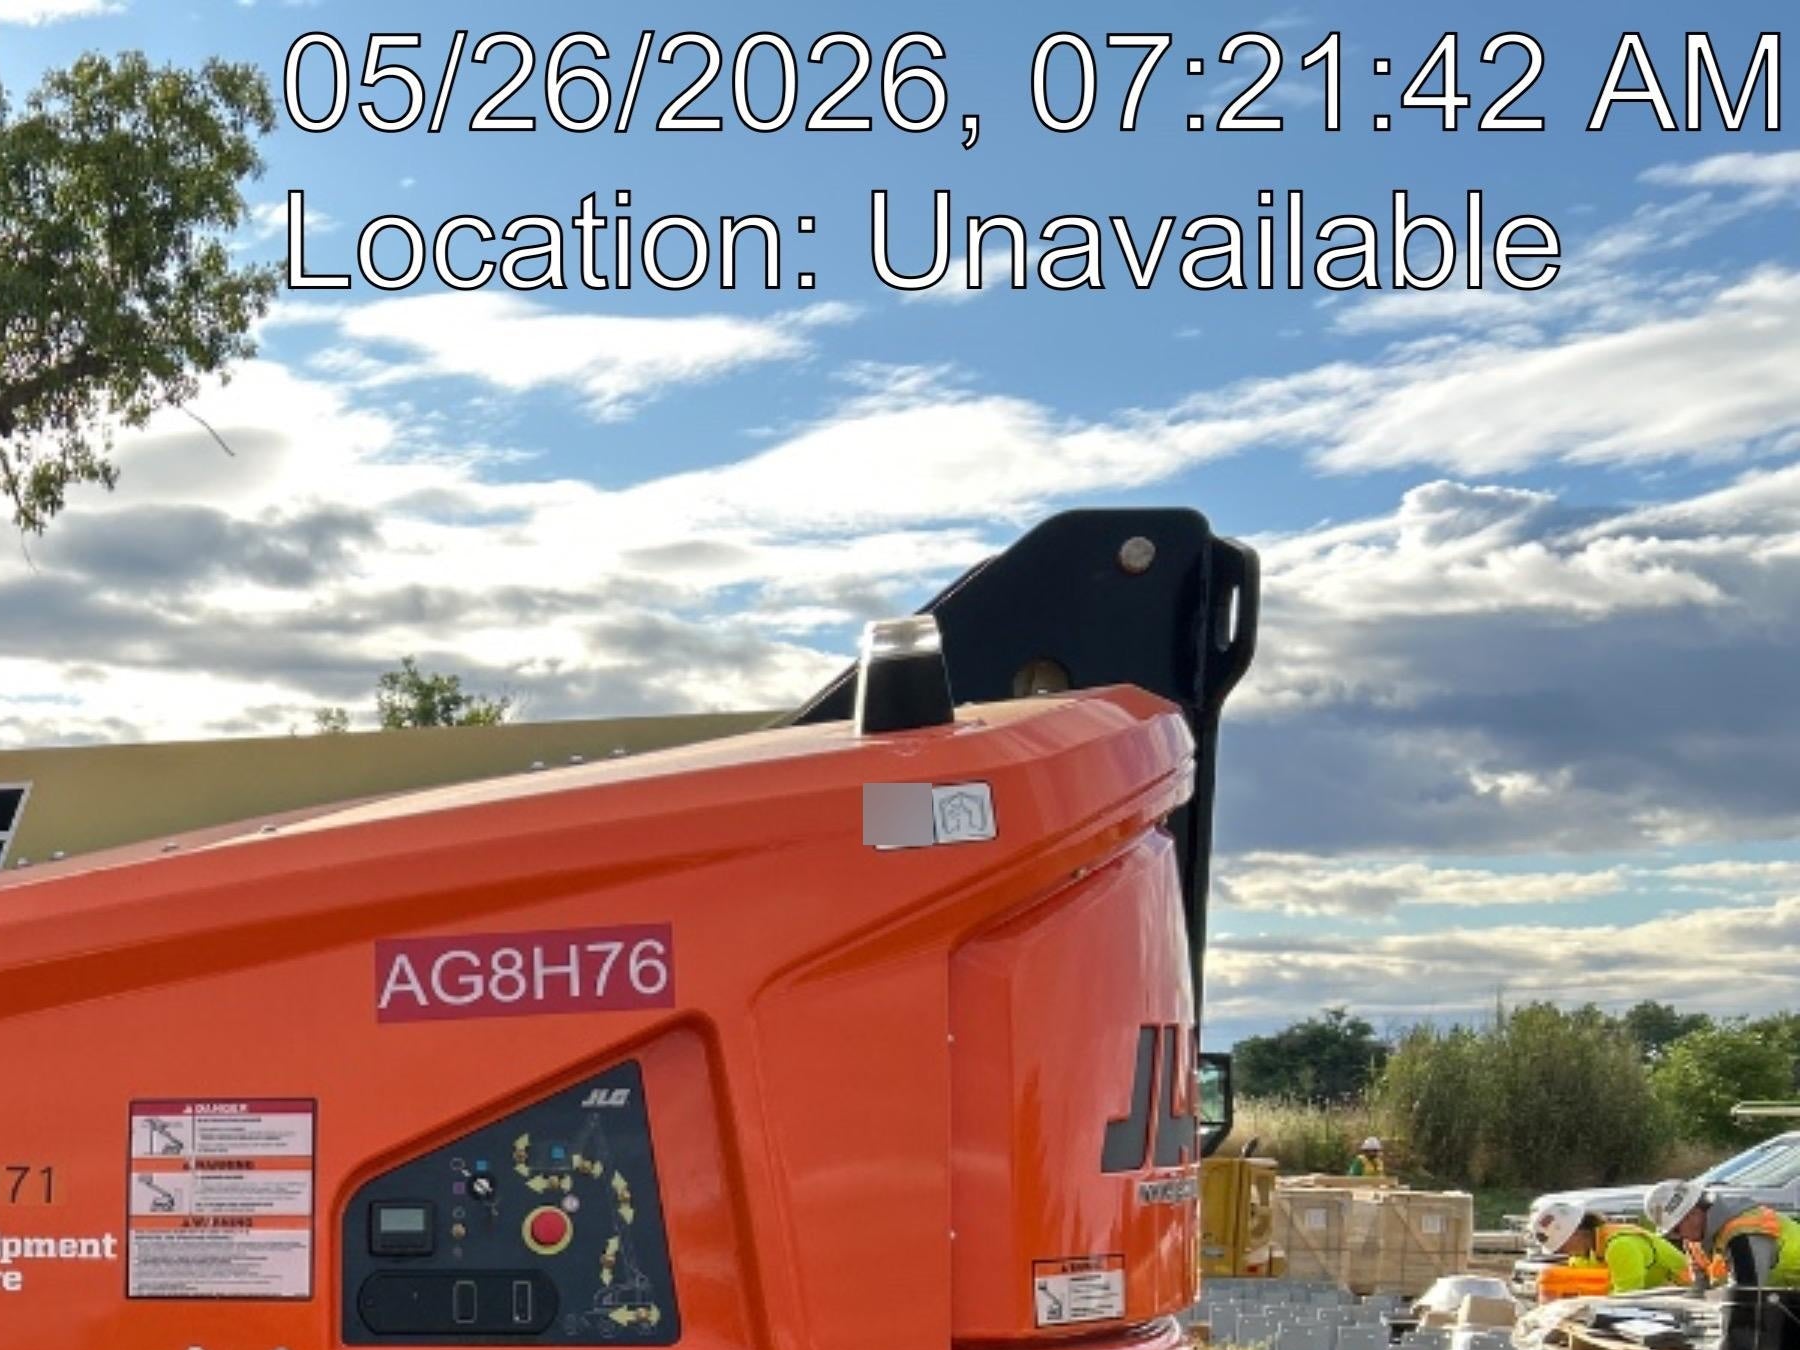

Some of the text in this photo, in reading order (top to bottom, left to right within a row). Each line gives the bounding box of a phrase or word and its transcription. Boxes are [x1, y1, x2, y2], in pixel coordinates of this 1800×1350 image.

[378, 939, 668, 1008] AG8H76
[581, 1088, 631, 1108] JLG
[1101, 1024, 1198, 1174] JL
